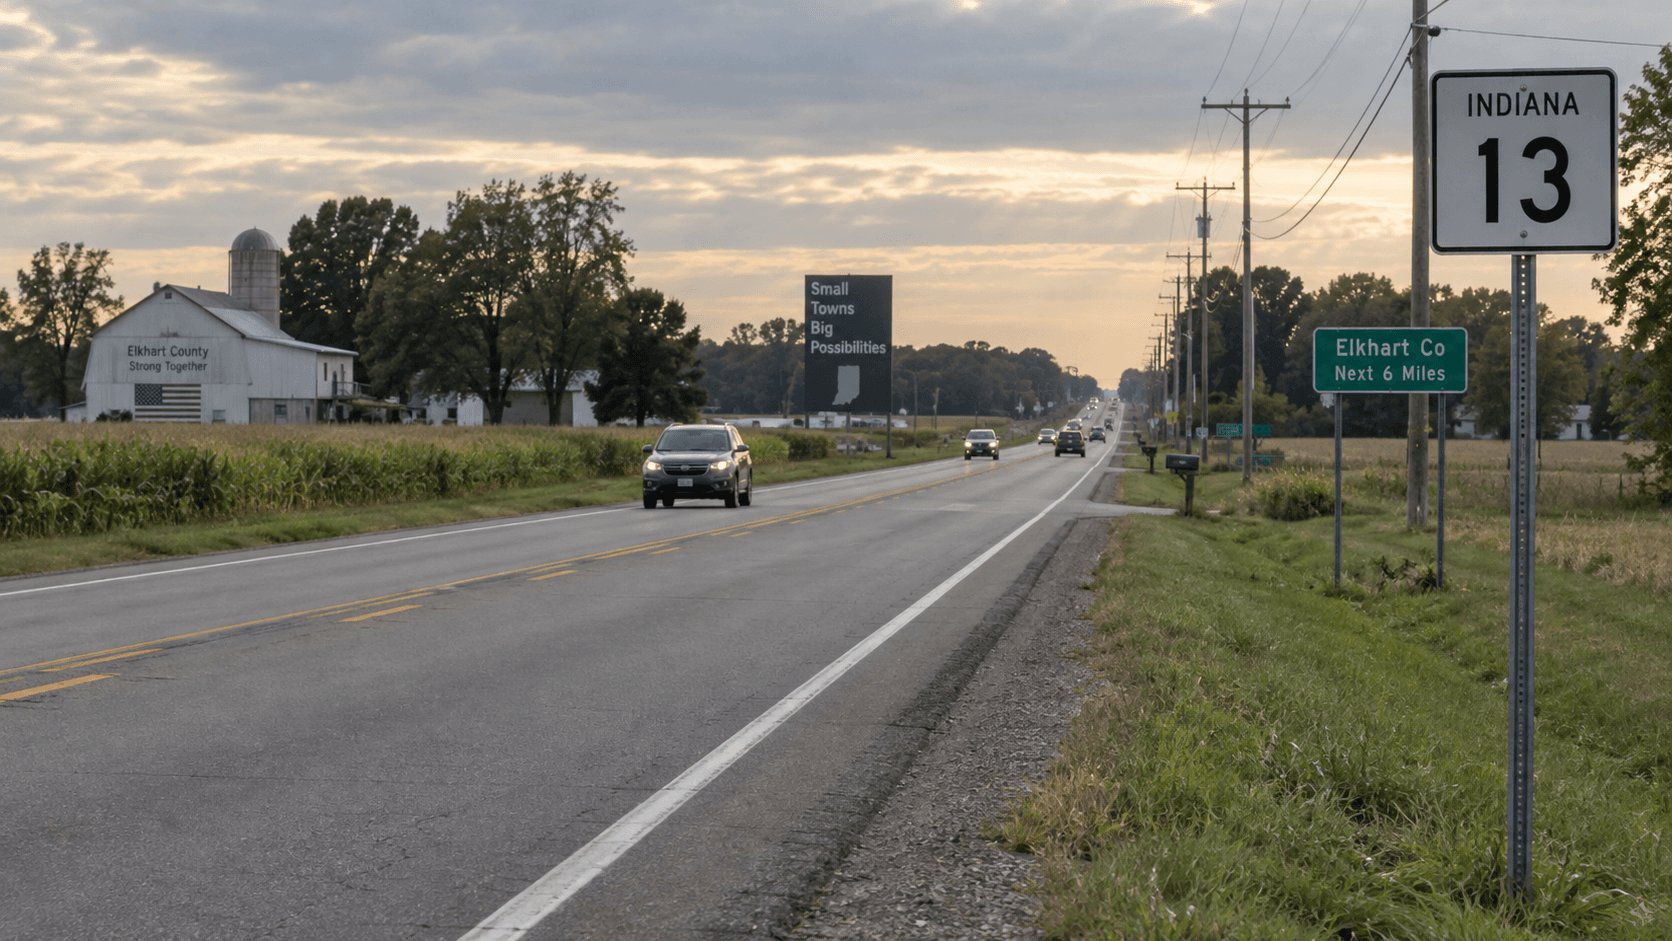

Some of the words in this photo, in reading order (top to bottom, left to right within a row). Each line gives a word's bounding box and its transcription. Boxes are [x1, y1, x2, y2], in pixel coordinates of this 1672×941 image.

[1468, 91, 1579, 117] INDIANA
[1478, 136, 1571, 223] 13
[811, 281, 849, 295] Small
[811, 301, 855, 315] Towns
[811, 320, 833, 338] Big
[128, 345, 166, 357] Elkhart
[170, 345, 208, 359] County
[811, 340, 886, 354] Possibilities
[1336, 338, 1410, 356] Elkhart
[1420, 338, 1446, 356] Co
[129, 361, 161, 373] Strong
[166, 361, 207, 373] Together
[1335, 365, 1374, 381] Next
[1383, 365, 1393, 381] 6
[1402, 365, 1446, 381] Miles
